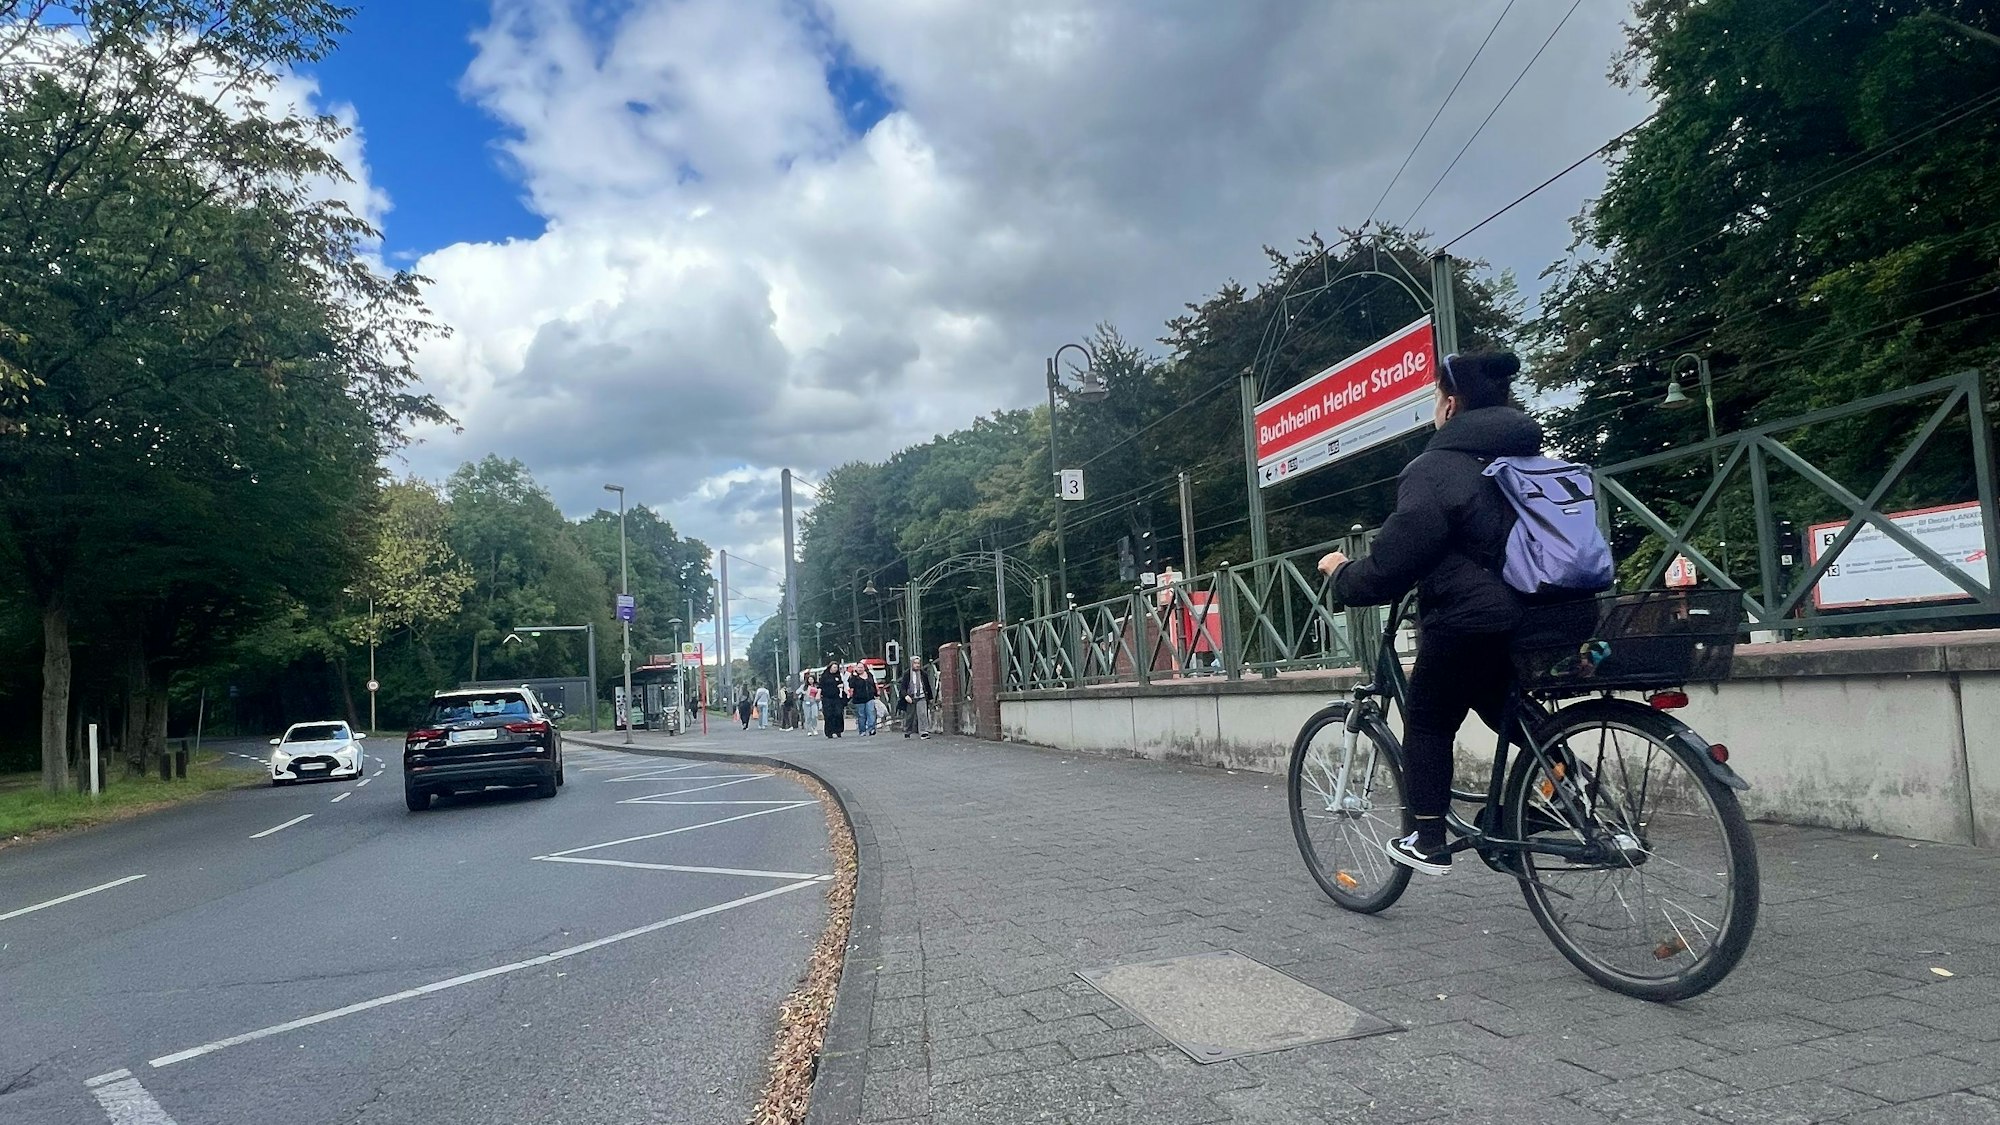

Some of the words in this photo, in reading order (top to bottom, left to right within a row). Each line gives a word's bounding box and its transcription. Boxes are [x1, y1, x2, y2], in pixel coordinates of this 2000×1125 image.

[1260, 404, 1321, 445] Buchheim
[1323, 380, 1368, 416] Herler
[1371, 351, 1427, 393] Straße
[1070, 480, 1079, 494] 3
[1825, 534, 1834, 545] 3
